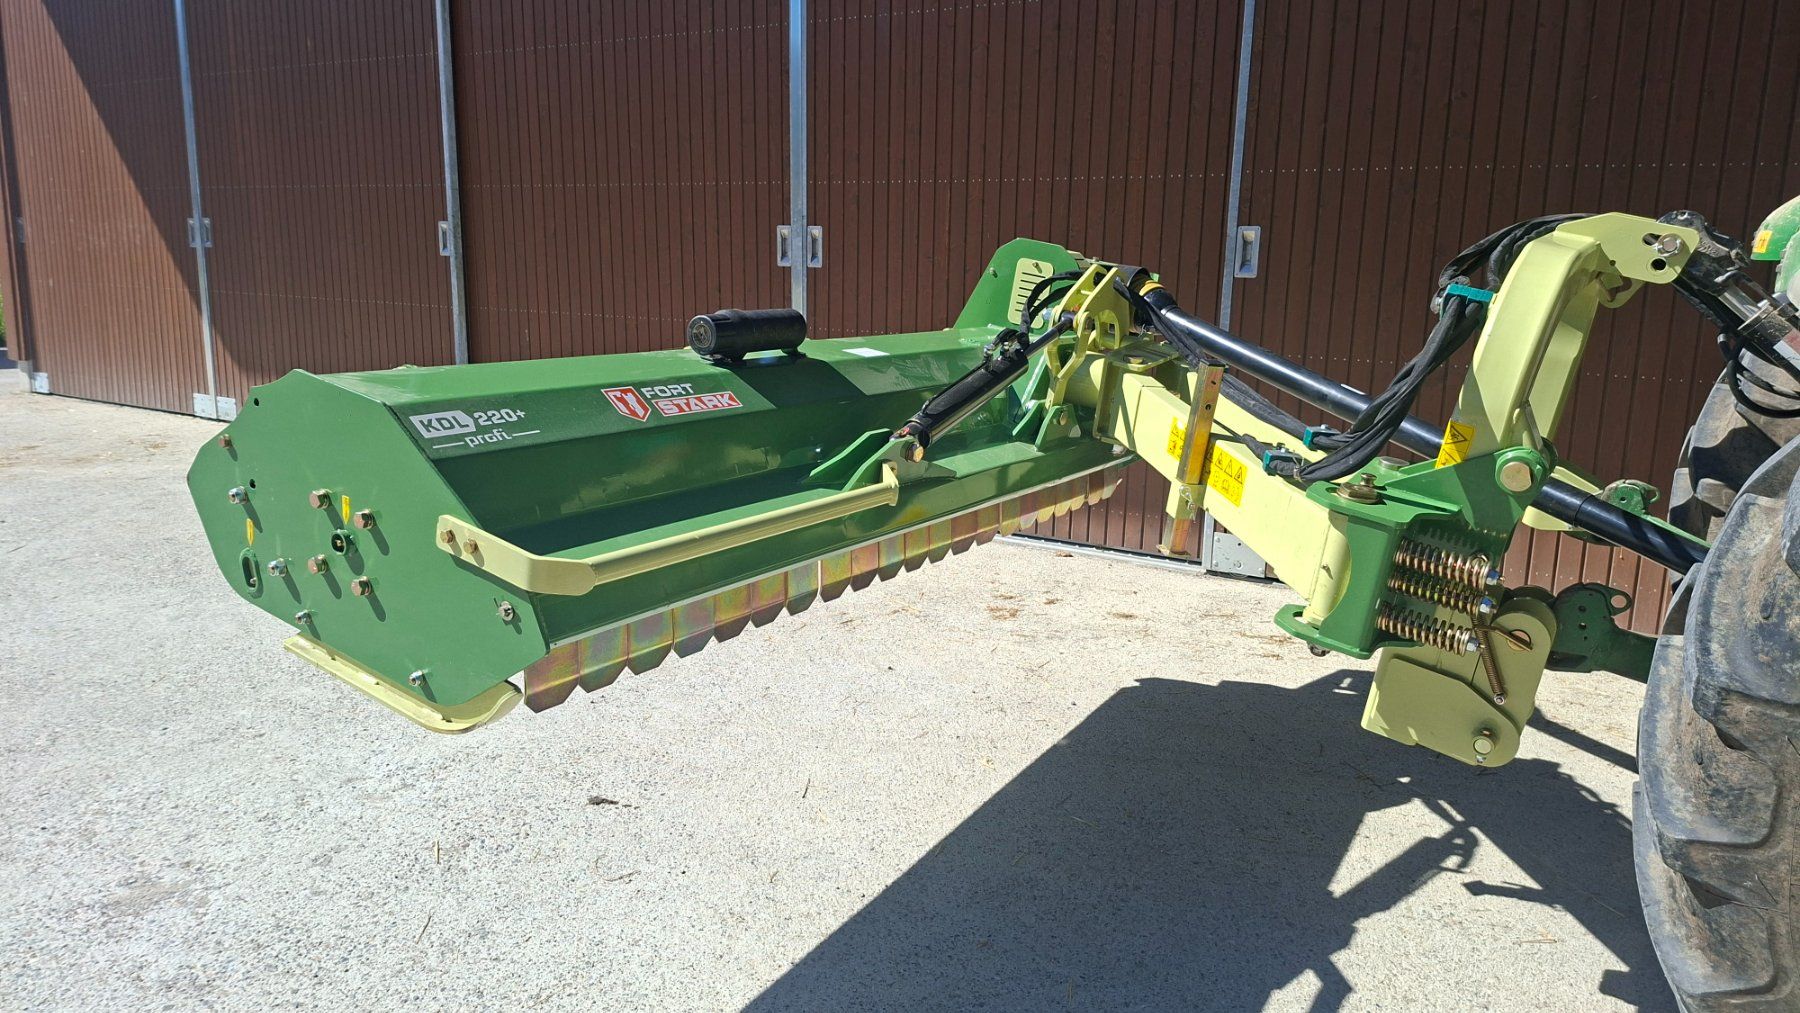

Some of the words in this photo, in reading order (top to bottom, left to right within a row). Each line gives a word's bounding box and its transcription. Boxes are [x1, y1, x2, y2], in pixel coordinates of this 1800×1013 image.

[640, 383, 695, 398] FORT
[657, 394, 737, 414] STARK
[418, 415, 470, 433] KDL
[473, 408, 526, 426] 220+
[464, 428, 512, 448] profi
